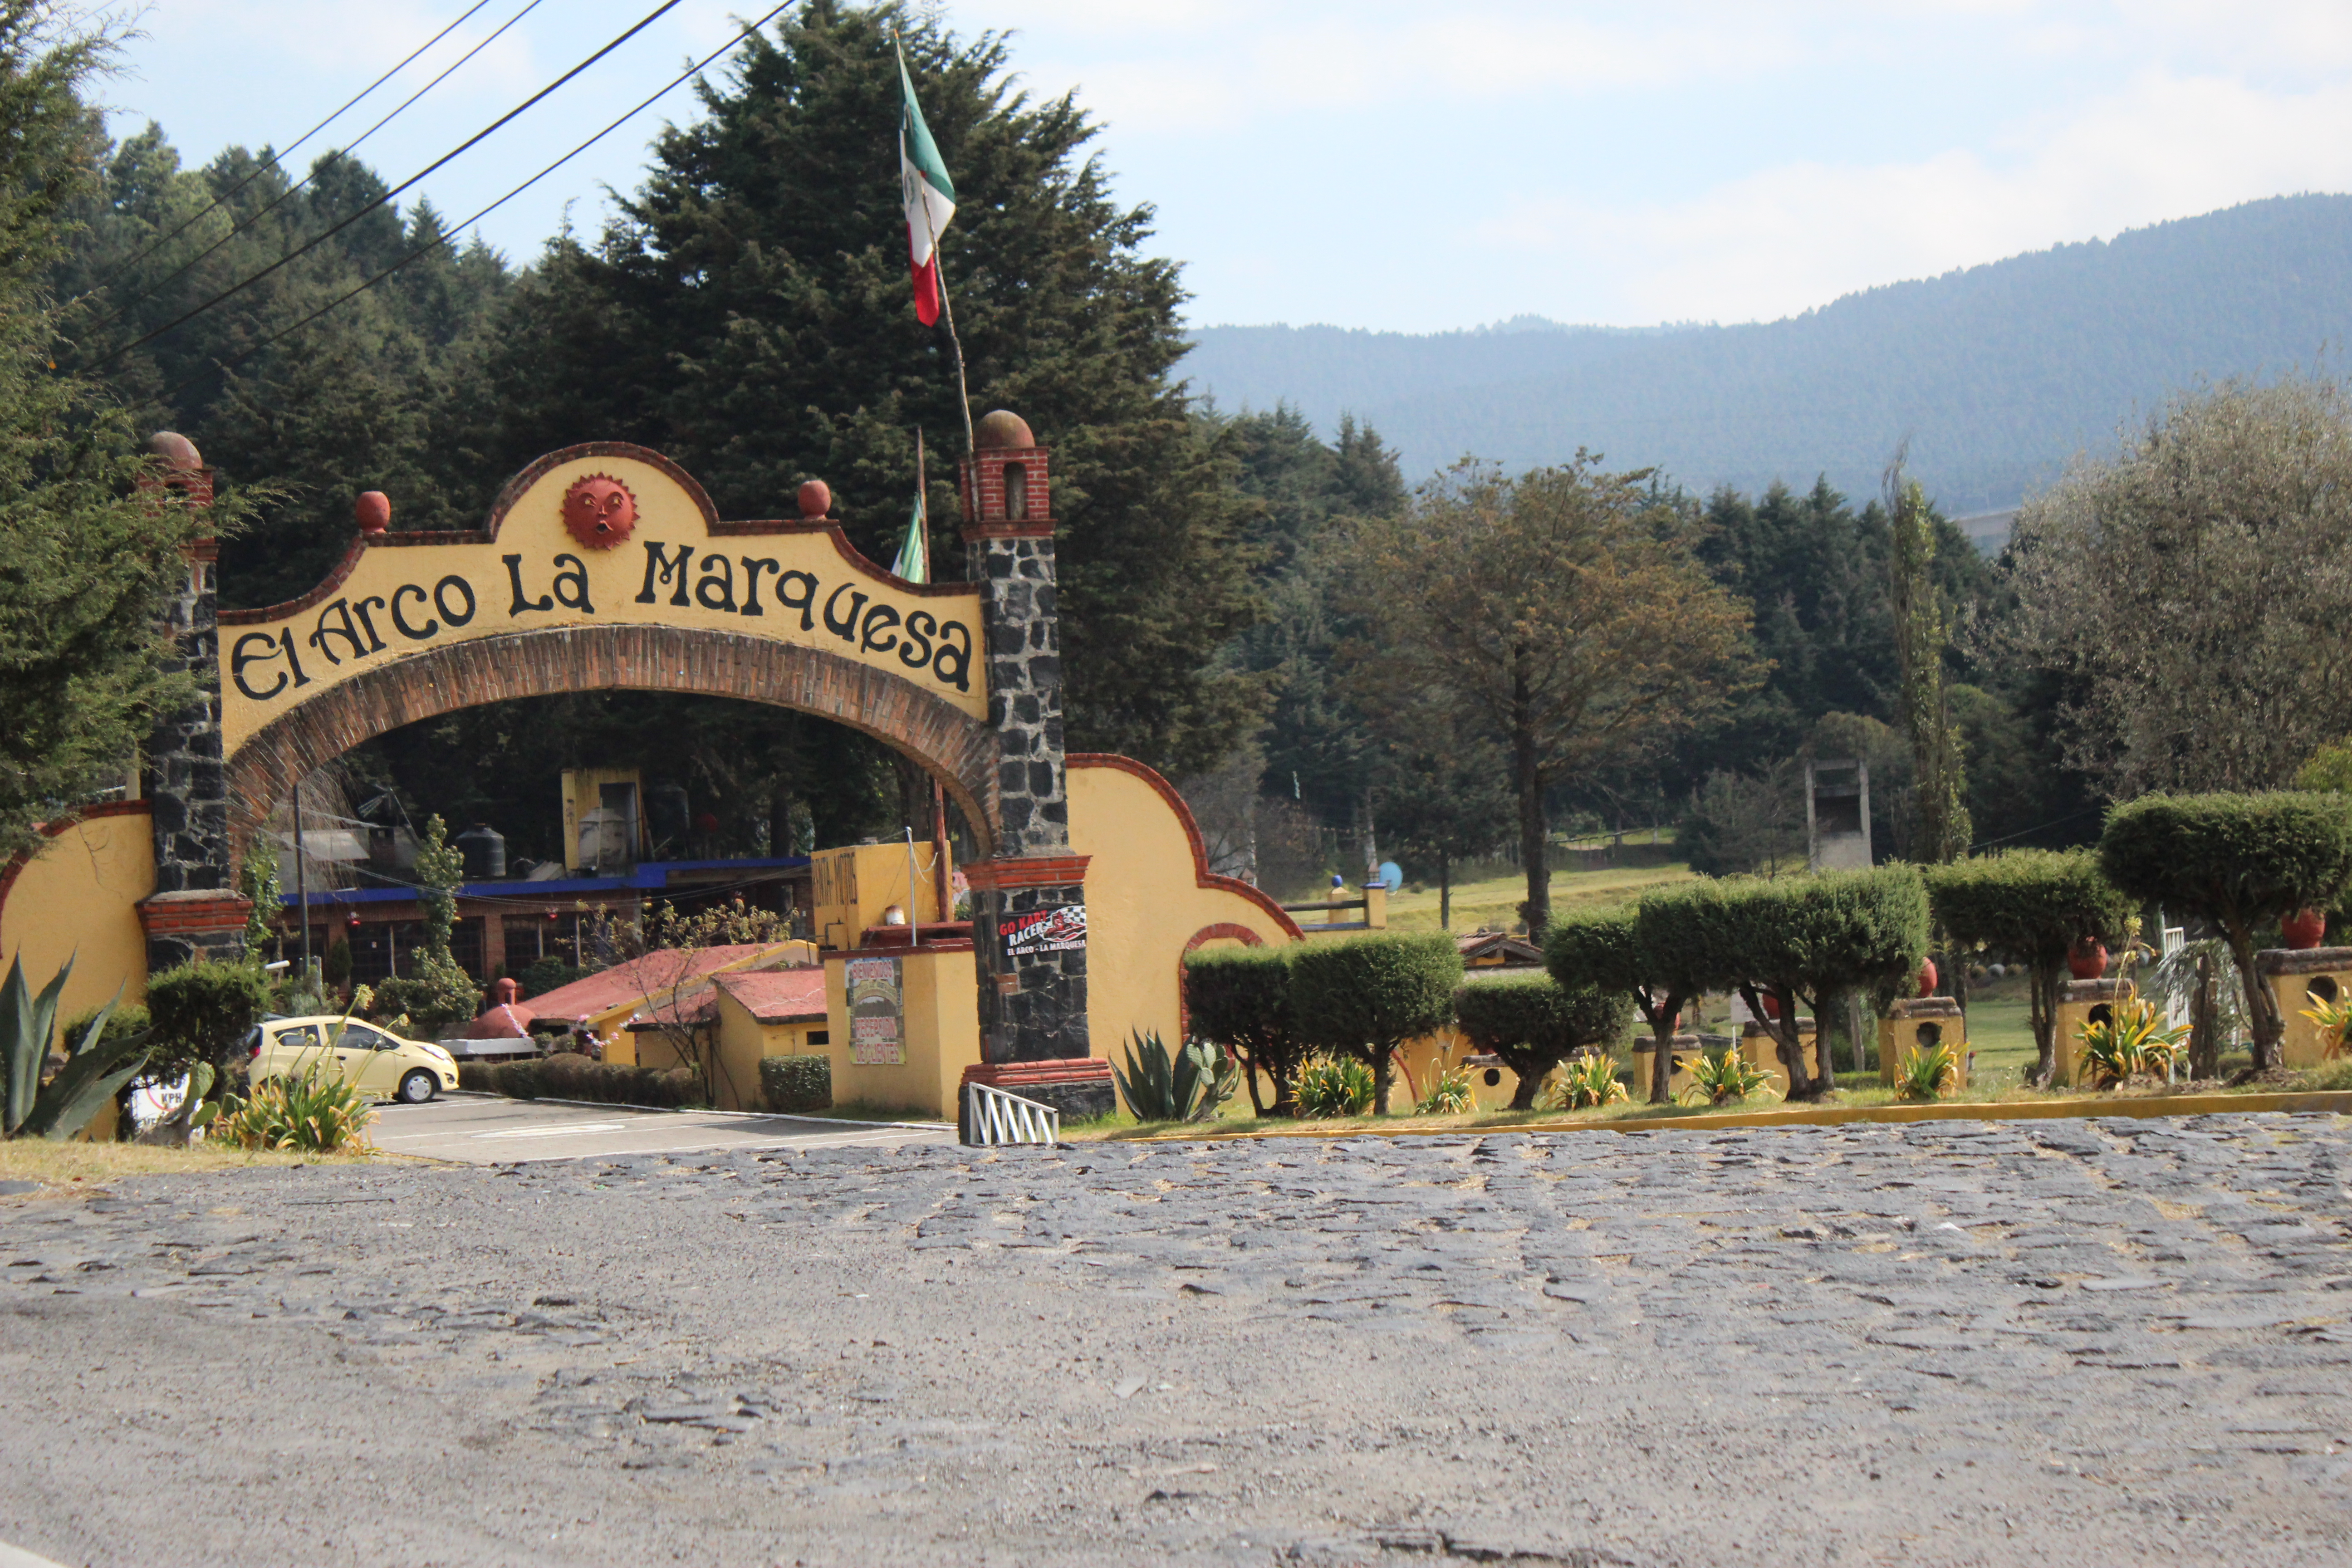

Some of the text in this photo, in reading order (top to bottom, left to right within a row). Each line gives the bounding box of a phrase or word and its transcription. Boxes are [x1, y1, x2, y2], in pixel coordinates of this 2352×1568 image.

[230, 541, 972, 700] El Arco La Marquesa
[999, 910, 1048, 936] GO KART
[1007, 948, 1015, 956] EL
[1016, 945, 1034, 955] ARCO
[1039, 944, 1049, 952] LA
[1050, 940, 1086, 951] MARQUESA
[853, 960, 893, 979] BIENVENIDOS
[161, 1092, 181, 1103] KPH
